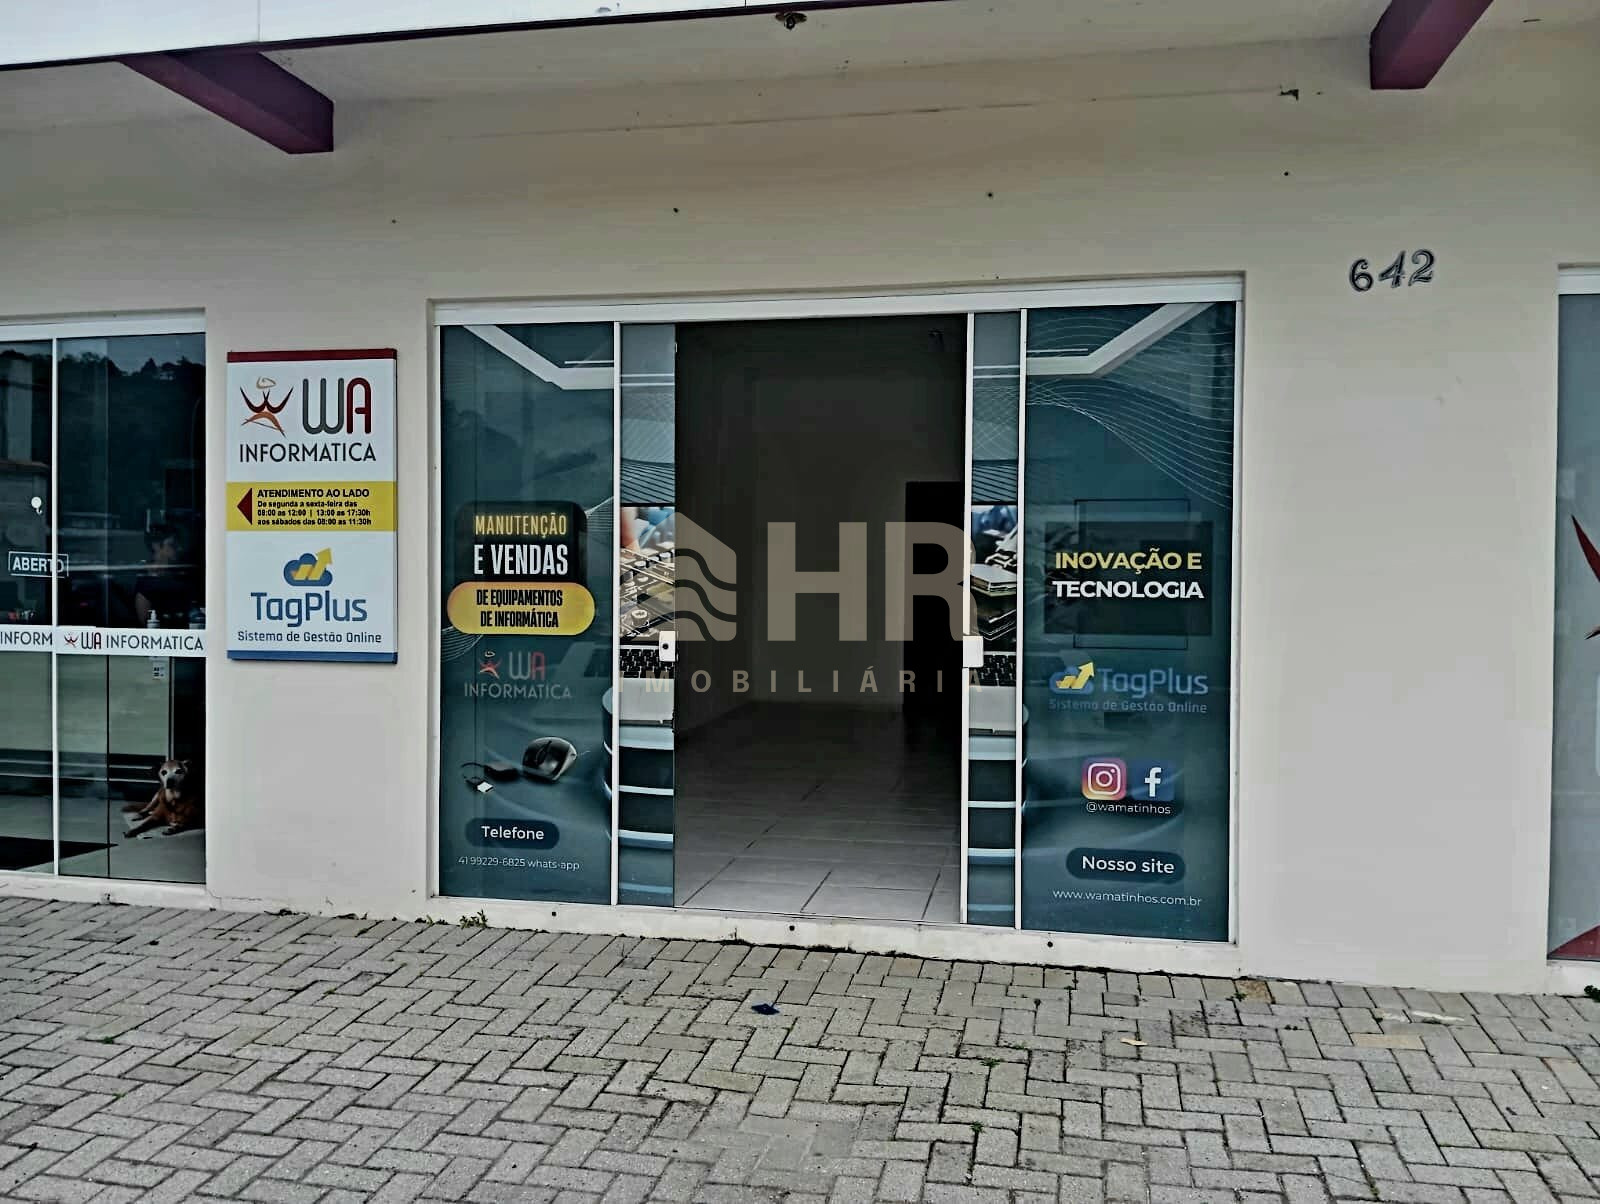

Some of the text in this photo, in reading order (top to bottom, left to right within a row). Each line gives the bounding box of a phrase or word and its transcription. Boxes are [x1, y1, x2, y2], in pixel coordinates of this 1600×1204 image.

[1349, 250, 1435, 292] 642
[302, 377, 373, 435] WA
[239, 442, 377, 463] INFORMATICA
[257, 488, 370, 498] ATENDIMENTO AO LADO
[257, 509, 276, 517] 08:00
[288, 509, 306, 517] 12:00
[316, 509, 335, 517] 13:00
[347, 509, 371, 517] 17:30h
[272, 517, 301, 526] sábados
[349, 518, 372, 526] 11:30h
[475, 512, 567, 539] MANUTENÇÃO
[473, 543, 569, 575] E VENDAS
[1055, 548, 1202, 576] INOVAÇÃO E
[476, 589, 563, 608] DE EQUIPAMENTOS
[1052, 580, 1205, 600] TECNOLOGIA
[250, 590, 368, 627] TagPlus
[480, 607, 559, 628] DE INFORMÁTICA
[81, 632, 204, 651] WA INFORMATICA
[237, 630, 382, 643] Sistema de Gestão Online
[509, 651, 546, 681] WA
[464, 682, 573, 699] INFORMATICA
[1098, 667, 1209, 699] TagPlus
[1048, 699, 1208, 714] Sistema de Gestão Online
[1086, 801, 1172, 815] @wamatinhos
[481, 825, 545, 840] Telefone
[458, 856, 468, 865] 41
[470, 856, 526, 867] 99229-6825
[1082, 855, 1175, 874] Nosso site
[1052, 889, 1202, 906] www.wamatinhos.com.br
